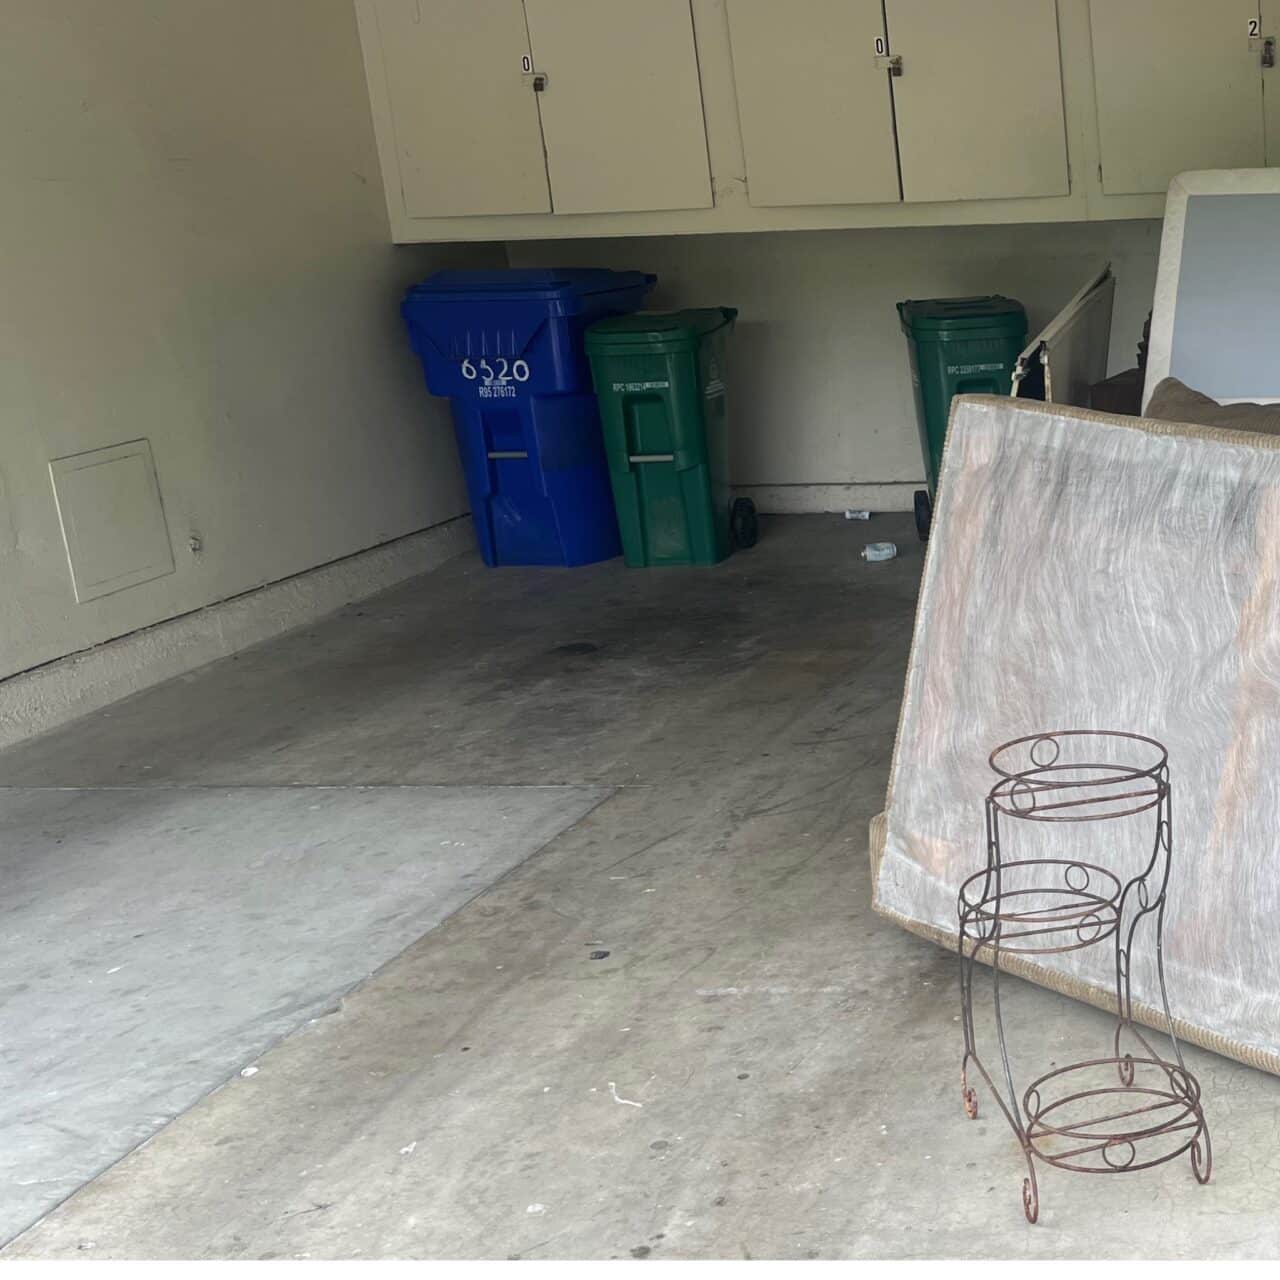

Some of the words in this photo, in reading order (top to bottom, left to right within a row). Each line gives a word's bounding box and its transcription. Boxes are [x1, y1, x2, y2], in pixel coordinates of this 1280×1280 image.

[1249, 20, 1258, 36] 2
[876, 38, 884, 54] 0
[522, 56, 530, 71] 0
[462, 358, 530, 381] 6520
